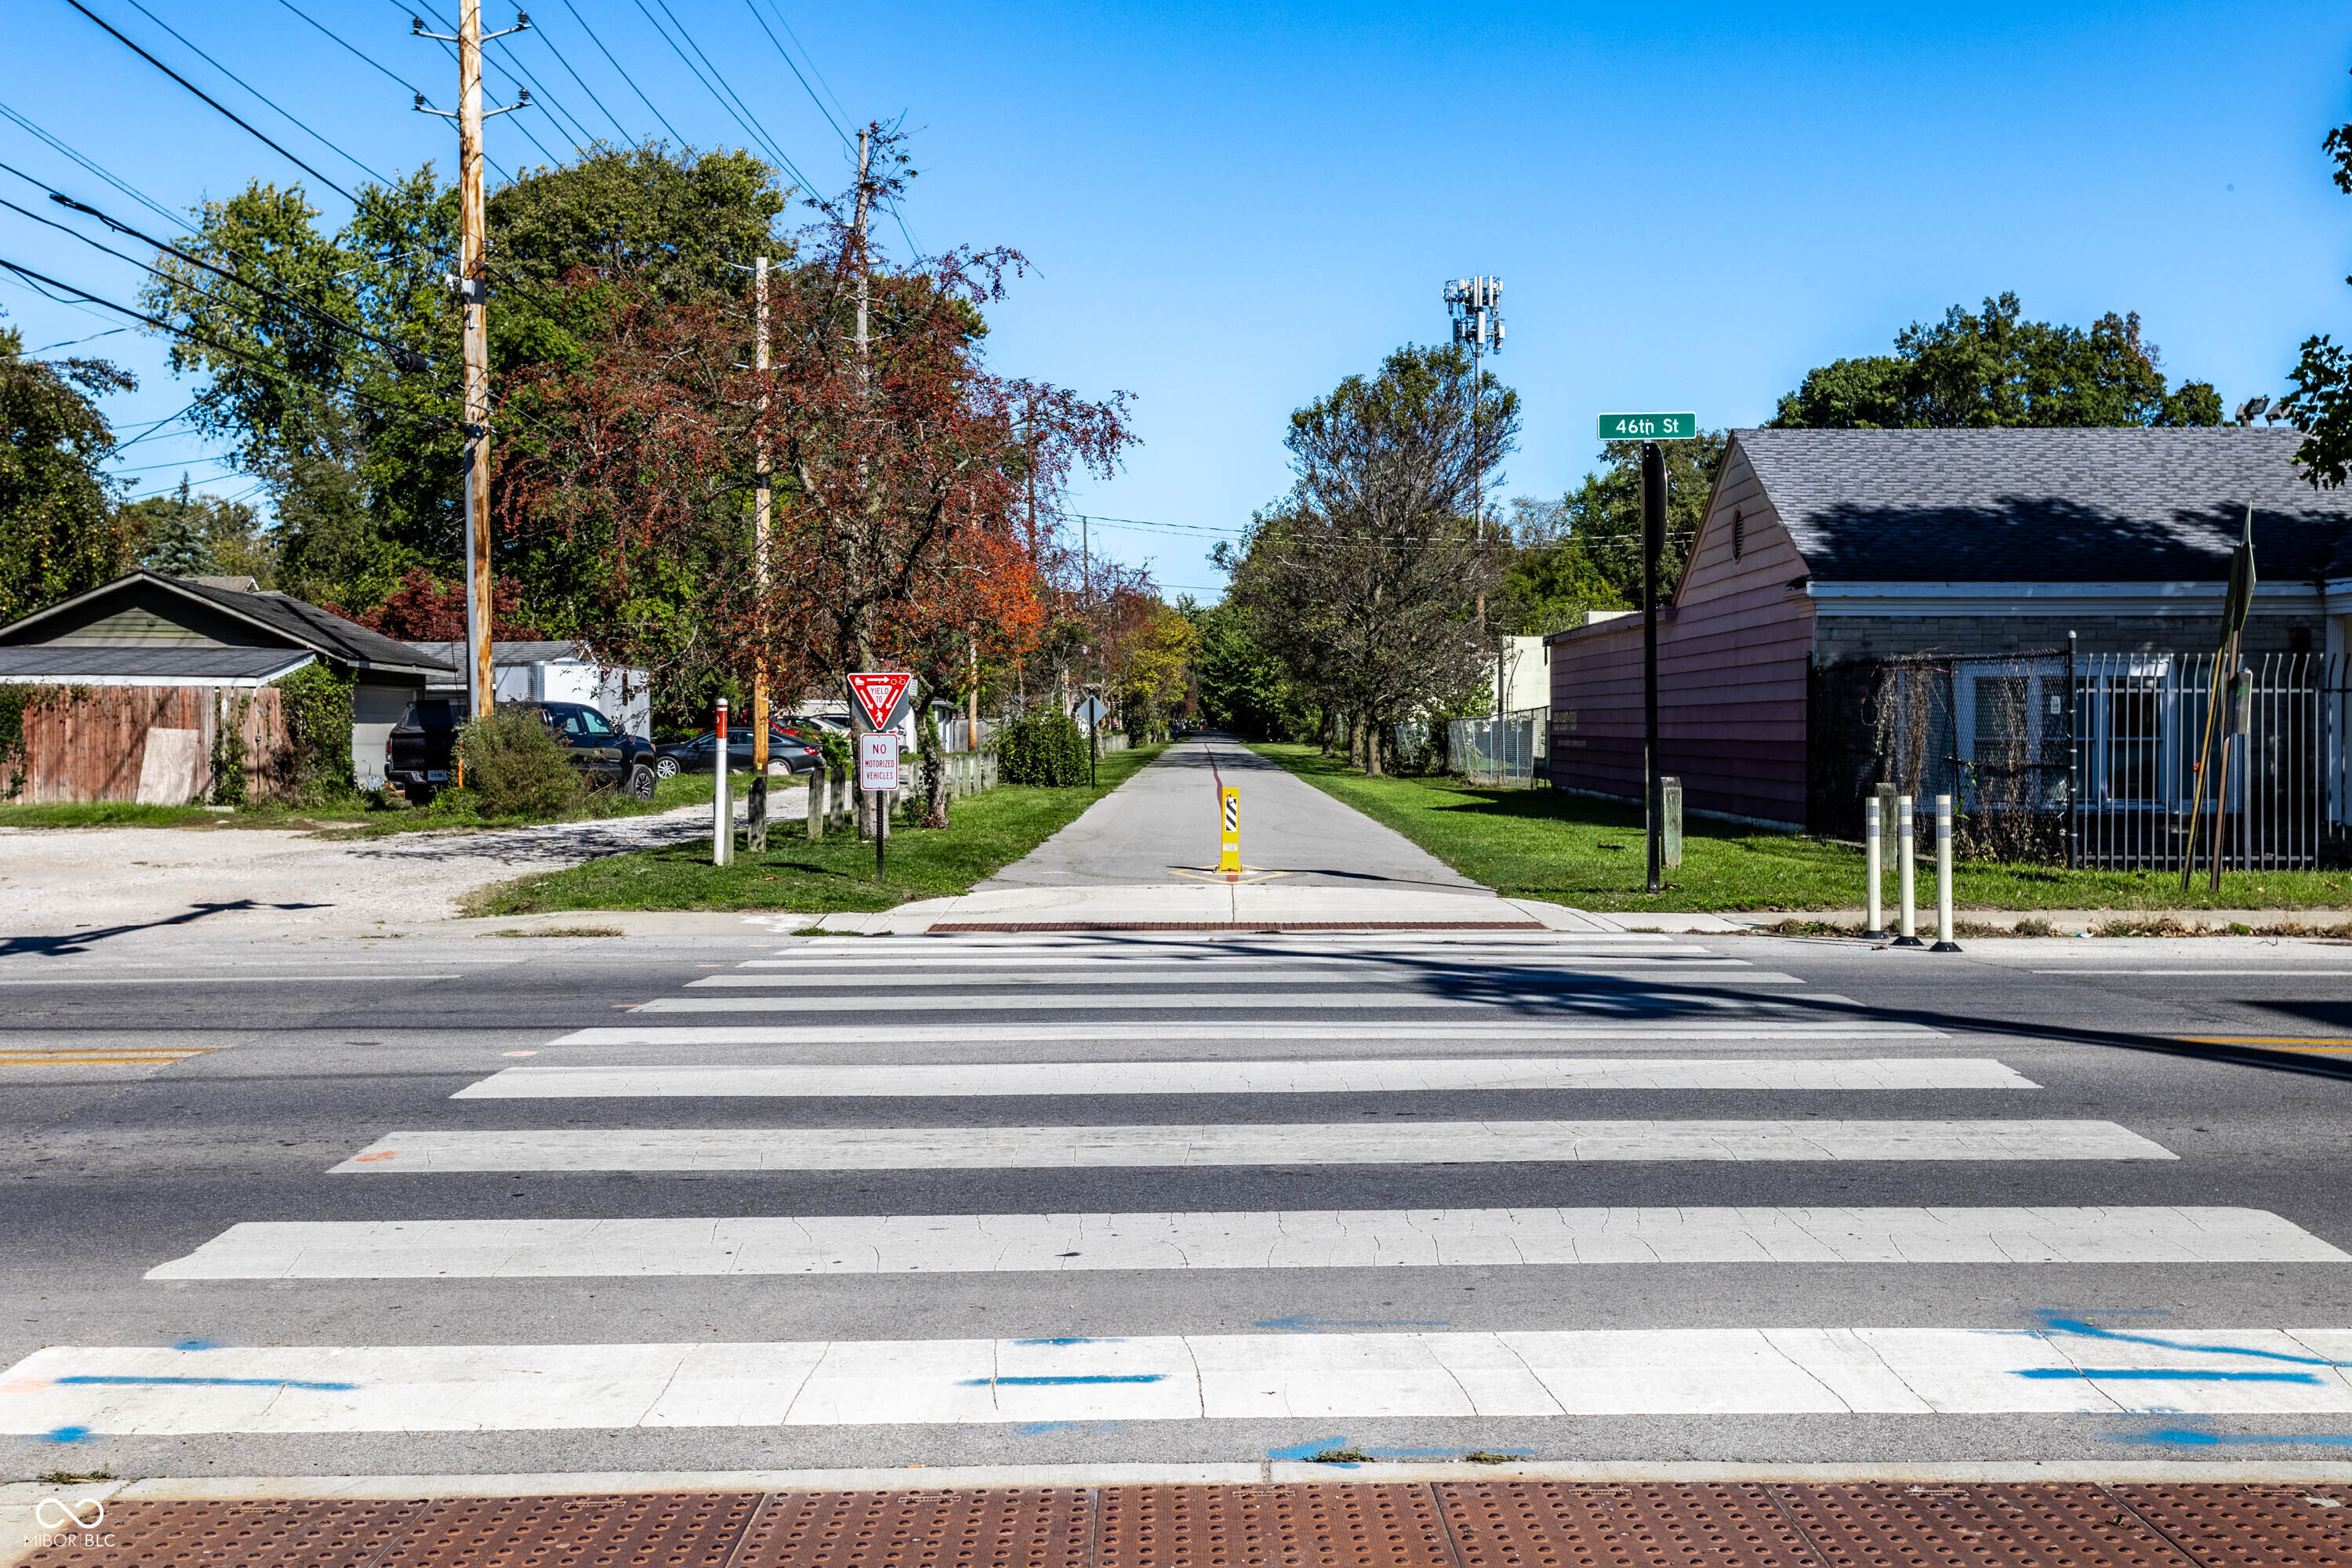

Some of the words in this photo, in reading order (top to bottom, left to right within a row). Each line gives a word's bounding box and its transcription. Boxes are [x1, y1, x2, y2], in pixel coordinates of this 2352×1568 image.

[1615, 419, 1654, 434] 46th
[1663, 418, 1679, 433] St
[873, 744, 887, 754] NO
[866, 771, 894, 780] VEHICLES
